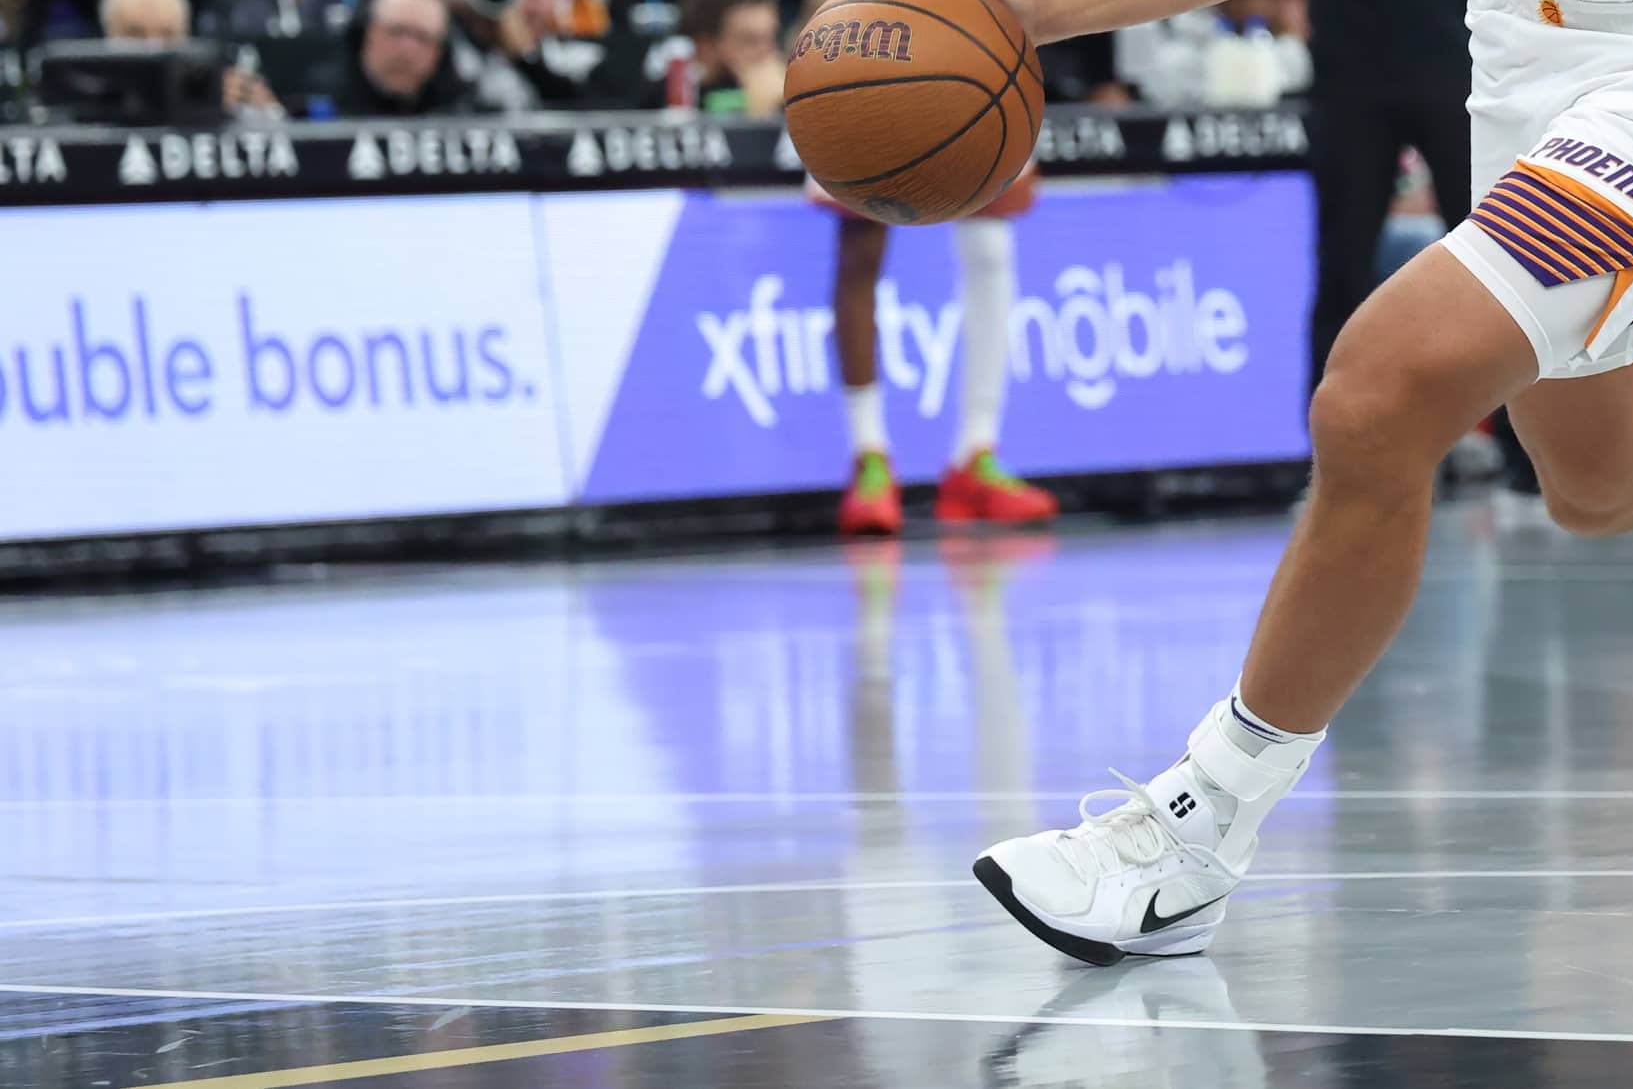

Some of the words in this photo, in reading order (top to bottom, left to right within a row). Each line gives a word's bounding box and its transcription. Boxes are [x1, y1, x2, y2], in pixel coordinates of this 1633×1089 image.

[787, 18, 913, 63] Wilso
[0, 135, 68, 185] TA
[160, 131, 300, 180] DELTA
[387, 127, 522, 176] DELTA
[604, 124, 733, 173] DELTA
[1035, 115, 1127, 161] ELTA
[1196, 113, 1309, 158] DELTA
[0, 293, 214, 425] uble
[238, 288, 538, 413] bonus.
[697, 272, 967, 428] xfinty
